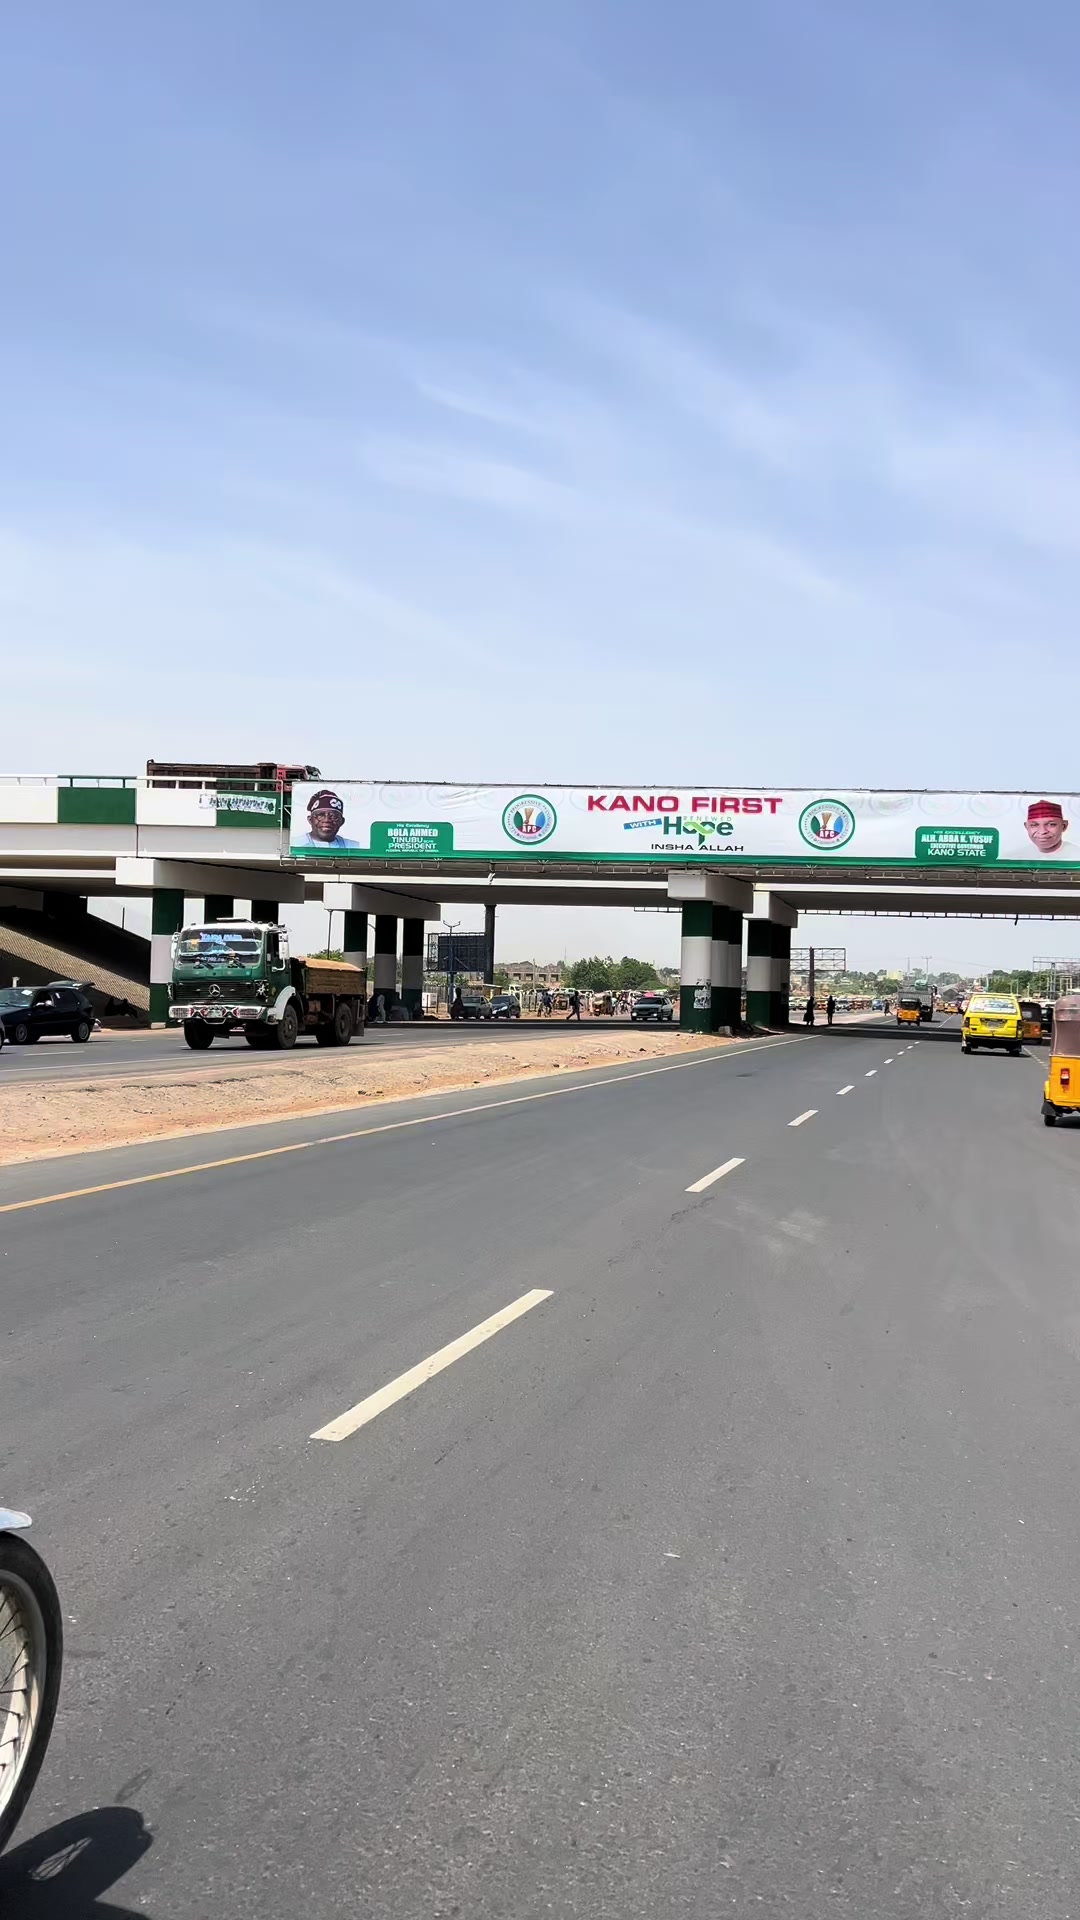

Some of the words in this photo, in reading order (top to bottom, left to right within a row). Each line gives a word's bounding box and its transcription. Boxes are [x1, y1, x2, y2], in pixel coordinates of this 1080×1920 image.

[588, 795, 679, 812] KANO
[692, 796, 783, 814] FIRST
[629, 819, 657, 829] WITH
[388, 828, 408, 836] BOLA
[410, 828, 438, 836] AHMED
[663, 816, 734, 846] Hope
[921, 834, 938, 843] ALH.
[938, 834, 959, 843] ABBA
[969, 835, 994, 844] YUSUF
